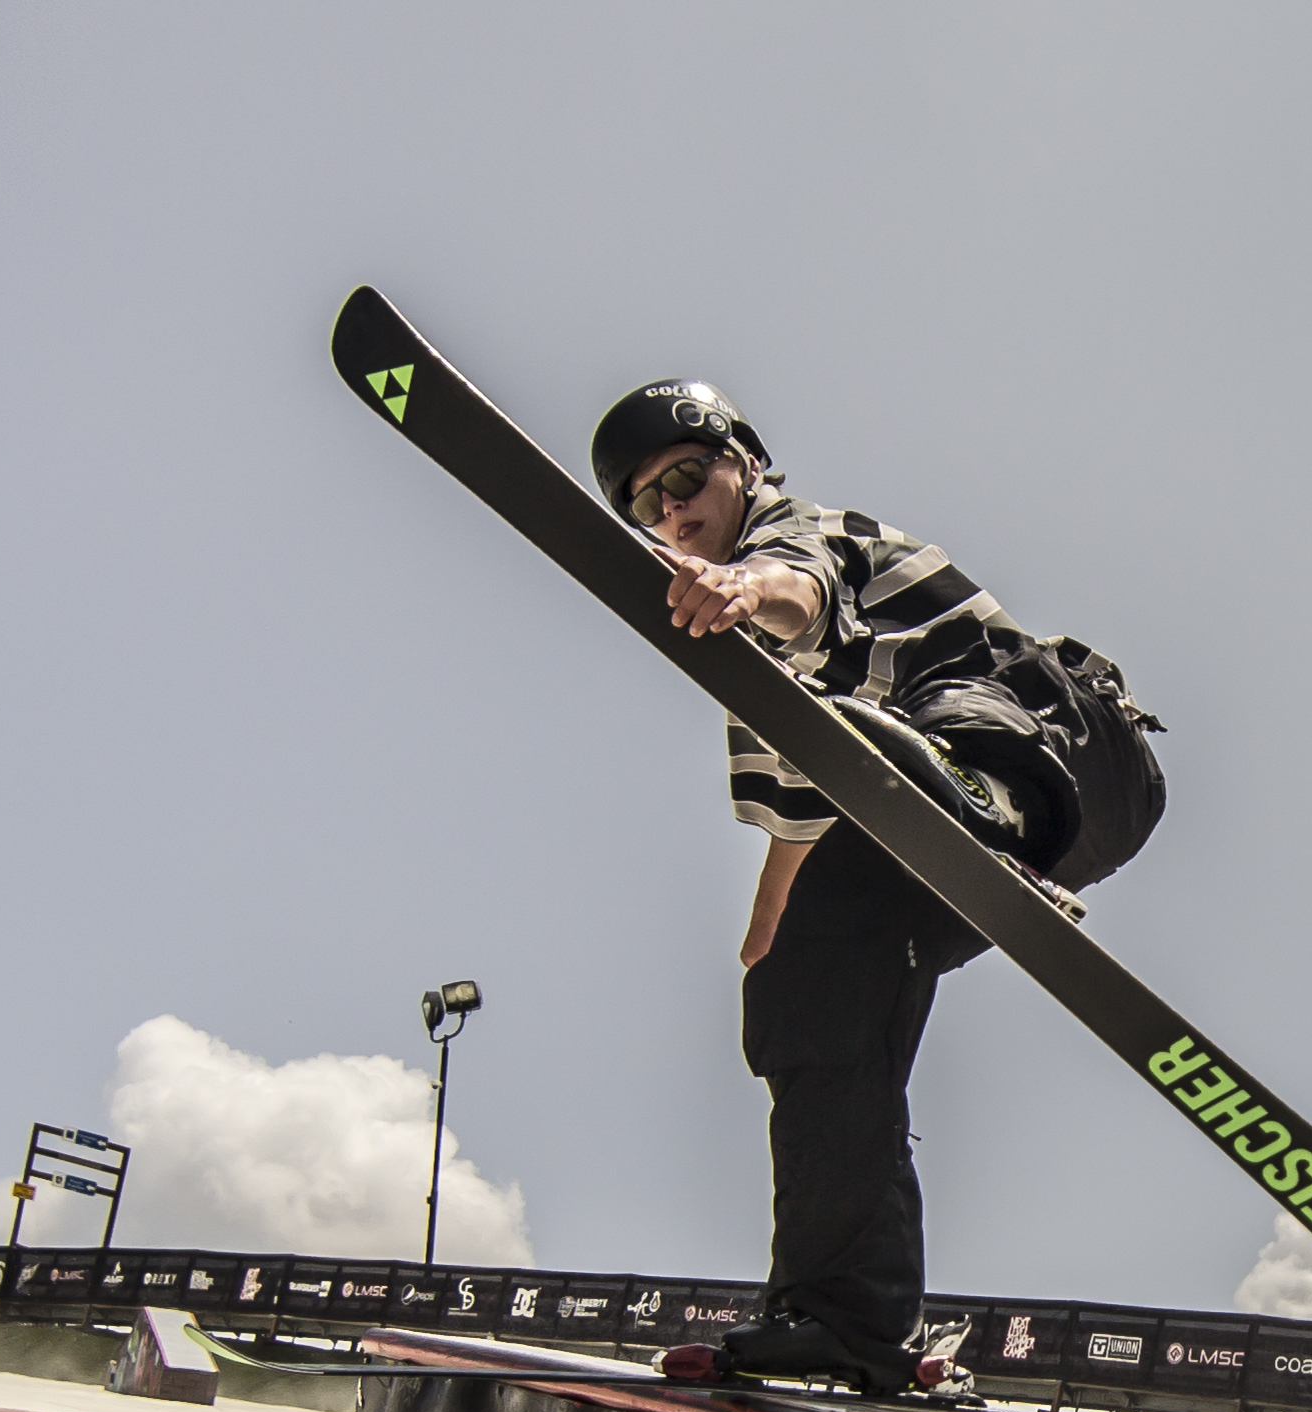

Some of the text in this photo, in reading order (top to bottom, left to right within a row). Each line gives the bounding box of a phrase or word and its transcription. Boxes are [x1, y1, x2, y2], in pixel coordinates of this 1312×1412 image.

[354, 1285, 388, 1298] LMSC
[697, 1307, 739, 1322] LMSC
[1110, 1339, 1139, 1355] UNION
[1187, 1347, 1246, 1368] LMSC
